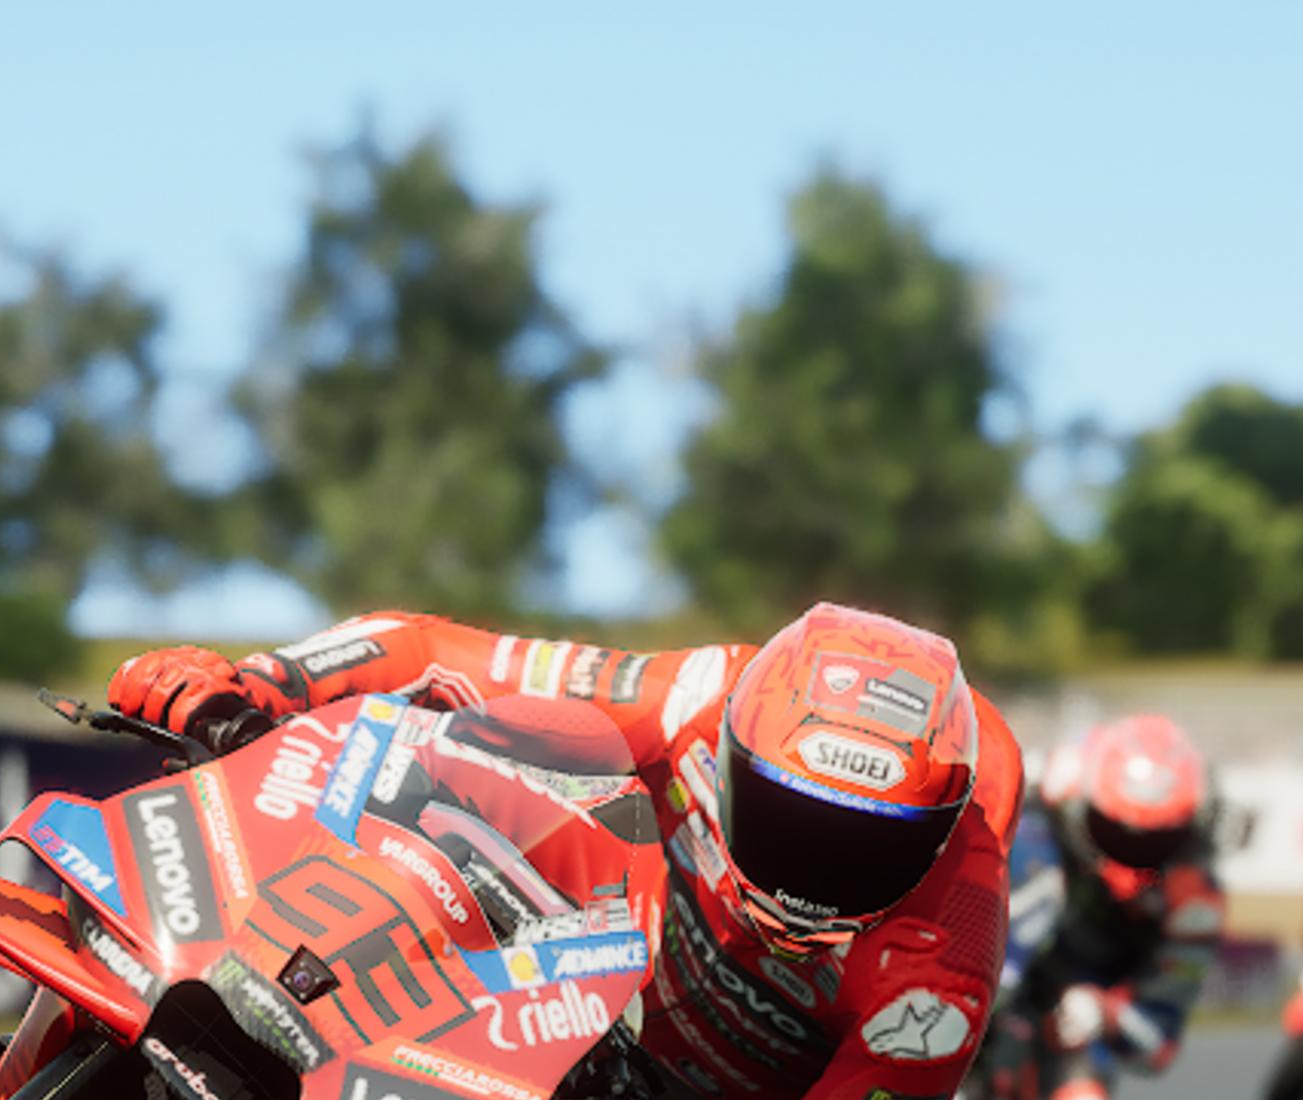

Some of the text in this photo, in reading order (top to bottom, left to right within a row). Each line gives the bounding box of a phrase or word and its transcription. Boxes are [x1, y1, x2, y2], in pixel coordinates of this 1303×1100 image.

[816, 741, 892, 782] SHOEI
[58, 841, 116, 894] TIM
[137, 793, 201, 936] Lenovo
[518, 981, 610, 1047] riello
